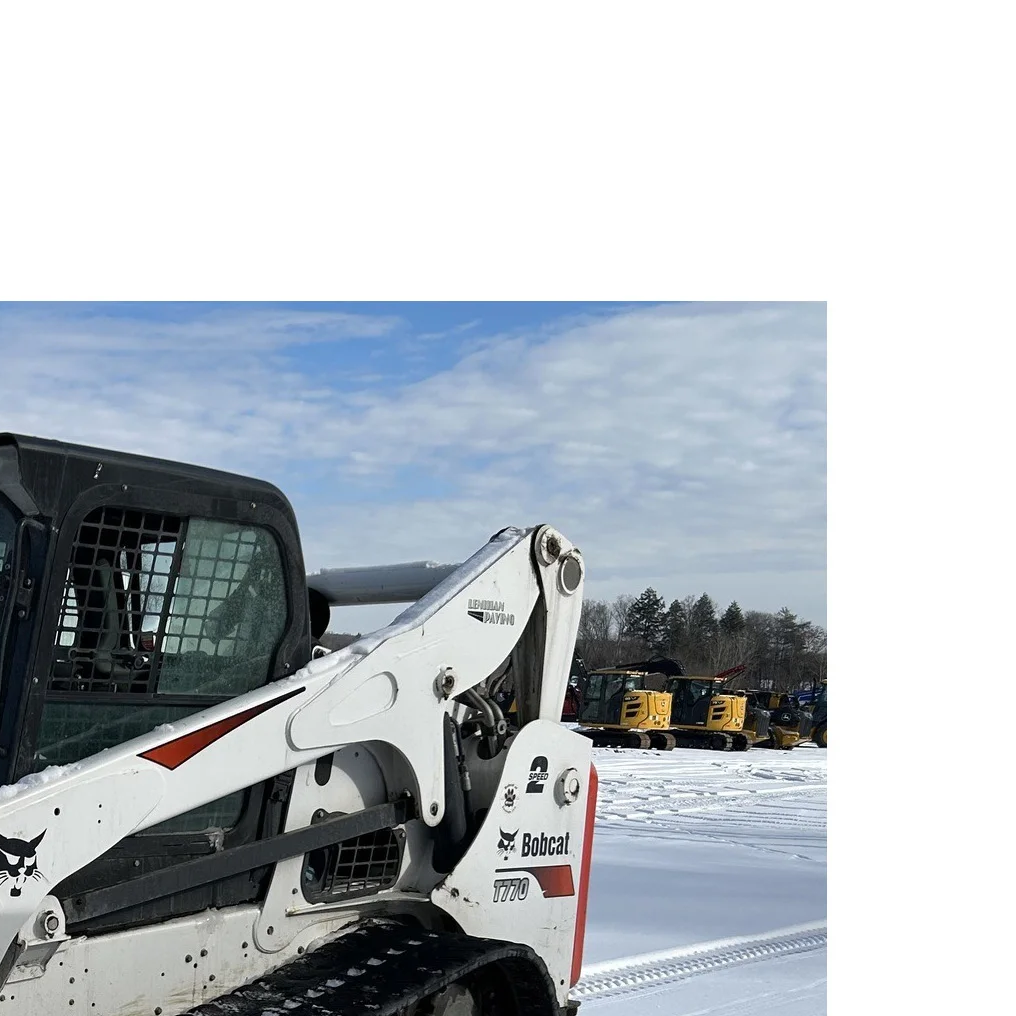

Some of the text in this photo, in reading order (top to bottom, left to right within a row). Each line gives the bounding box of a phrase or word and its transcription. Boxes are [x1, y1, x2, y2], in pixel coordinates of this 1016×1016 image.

[525, 755, 549, 794] 2
[528, 772, 549, 781] SPEED
[521, 832, 570, 857] Bobcat
[493, 877, 530, 903] T770
